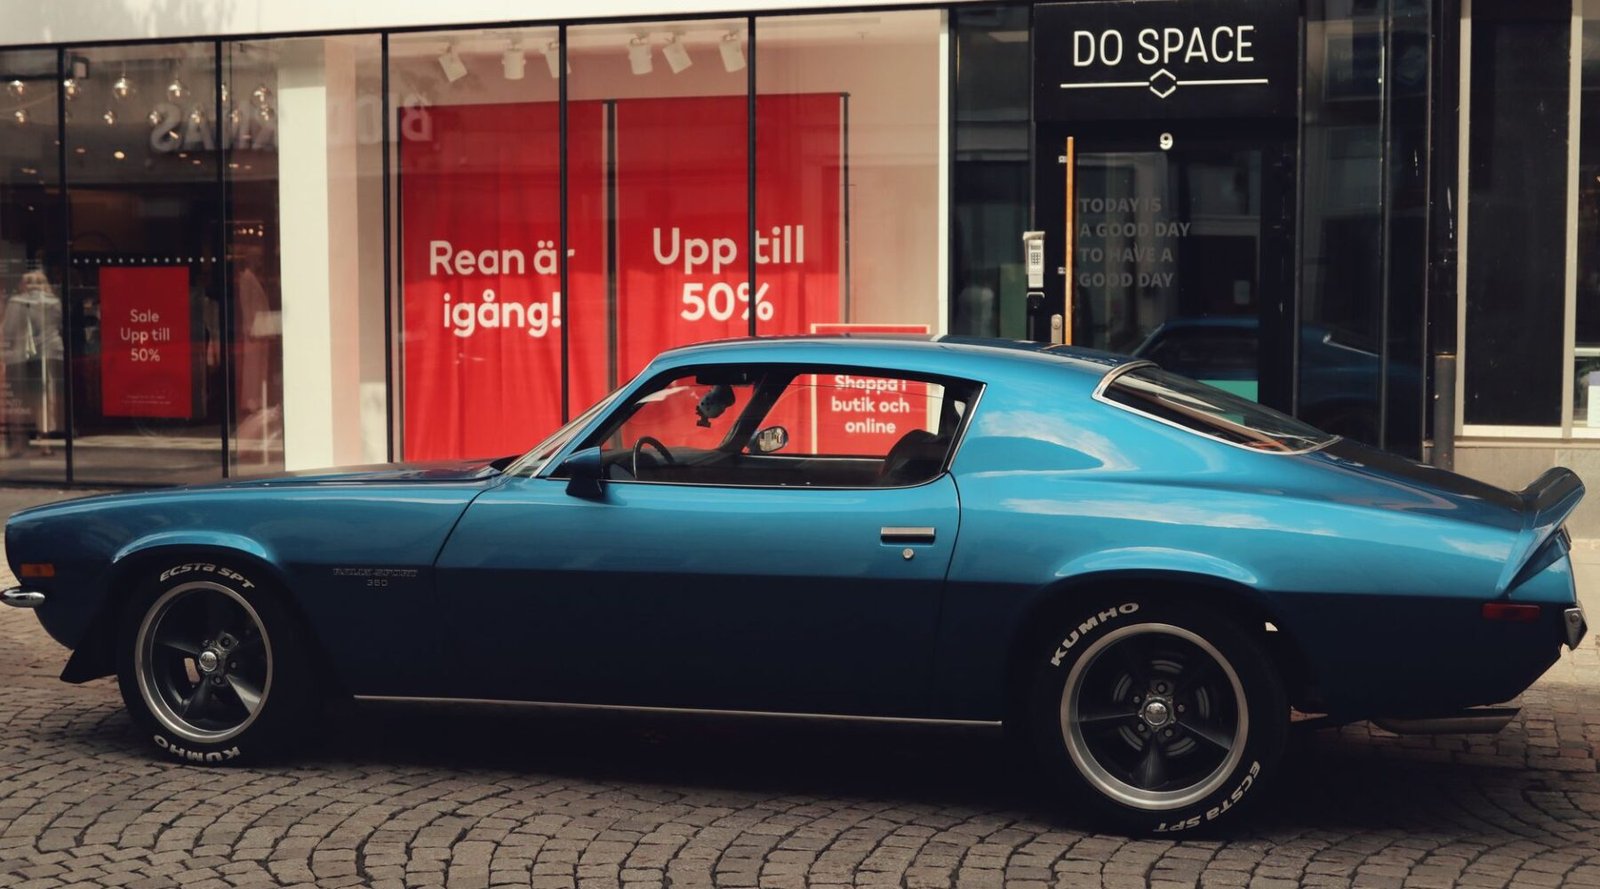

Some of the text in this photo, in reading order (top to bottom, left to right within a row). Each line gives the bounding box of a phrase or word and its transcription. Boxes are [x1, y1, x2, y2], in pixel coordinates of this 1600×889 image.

[1073, 25, 1255, 67] DO SPACE
[1159, 132, 1174, 150] 9
[1080, 198, 1161, 213] TODAY IS
[1080, 222, 1191, 238] A GOOD DAY
[430, 240, 525, 276] Rean
[653, 225, 804, 275] Upp till
[1080, 247, 1173, 263] TO HAVE A
[1079, 272, 1174, 288] GOOD DAY
[680, 281, 774, 321] 50%
[130, 308, 160, 323] Sale
[443, 288, 561, 338] igång!
[120, 327, 170, 345] Upp till
[130, 347, 161, 362] 50%
[834, 374, 899, 395] Shoppa
[831, 396, 910, 413] butik och
[844, 418, 896, 434] online
[217, 567, 255, 589] SPT
[1051, 602, 1140, 667] KUMHO
[153, 734, 241, 762] KUMHO
[1153, 815, 1202, 833] SPT
